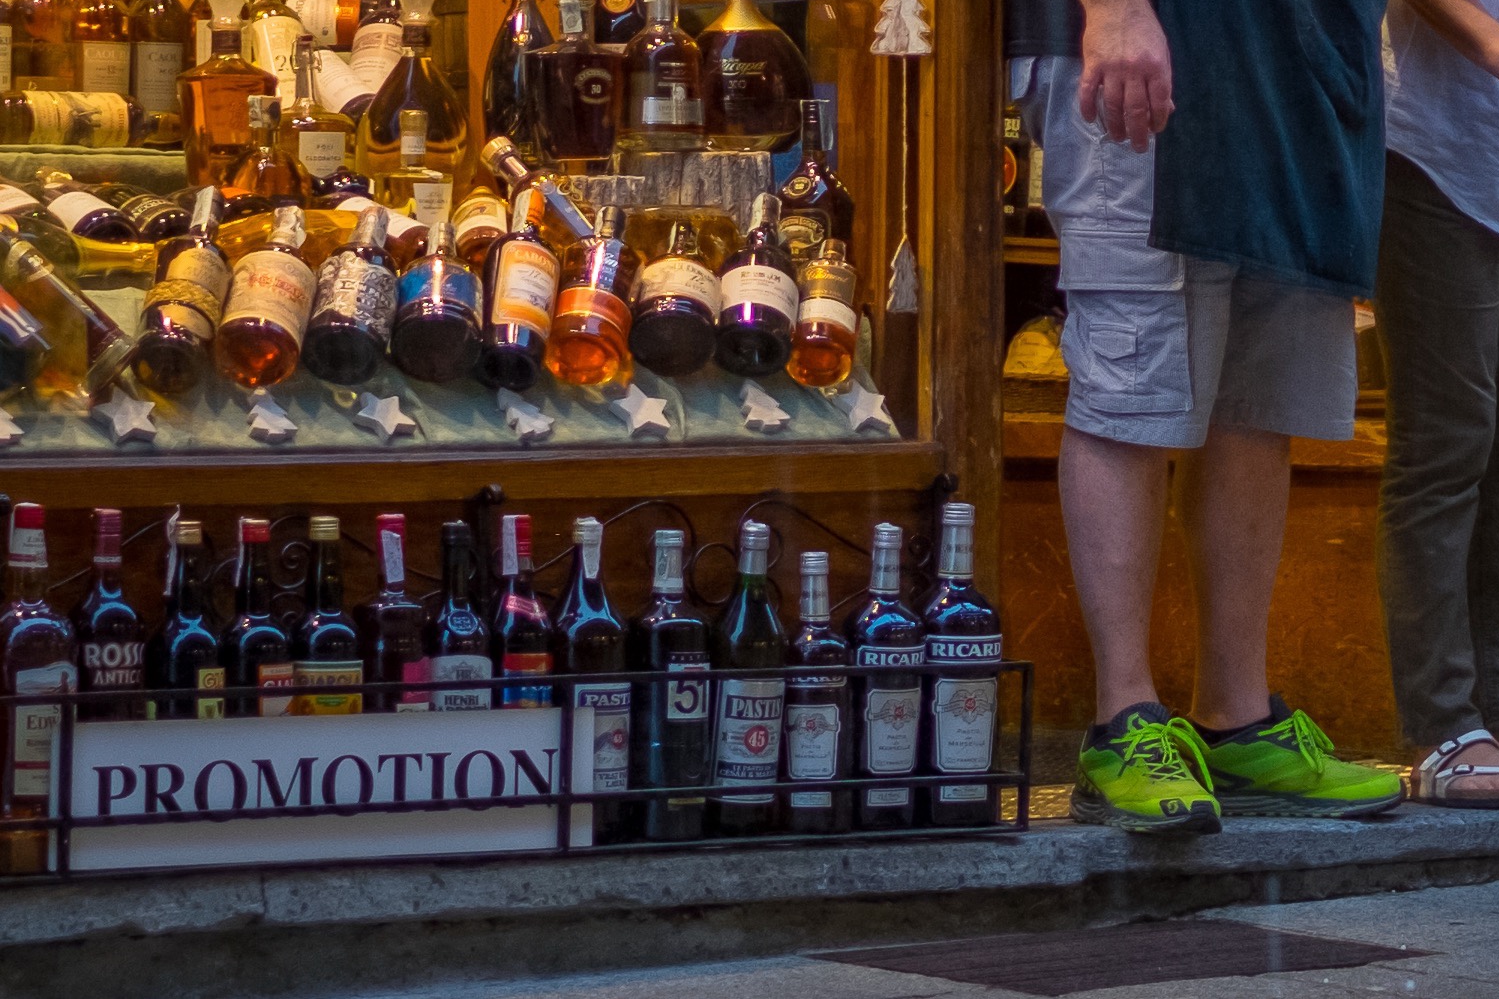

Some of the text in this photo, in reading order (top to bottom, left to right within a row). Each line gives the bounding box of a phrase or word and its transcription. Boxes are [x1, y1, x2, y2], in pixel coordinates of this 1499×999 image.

[931, 642, 1001, 657] RICARD
[673, 666, 708, 714] 51
[730, 698, 782, 719] PASTIS
[748, 729, 766, 748] 45
[92, 749, 560, 821] PROMOTION
